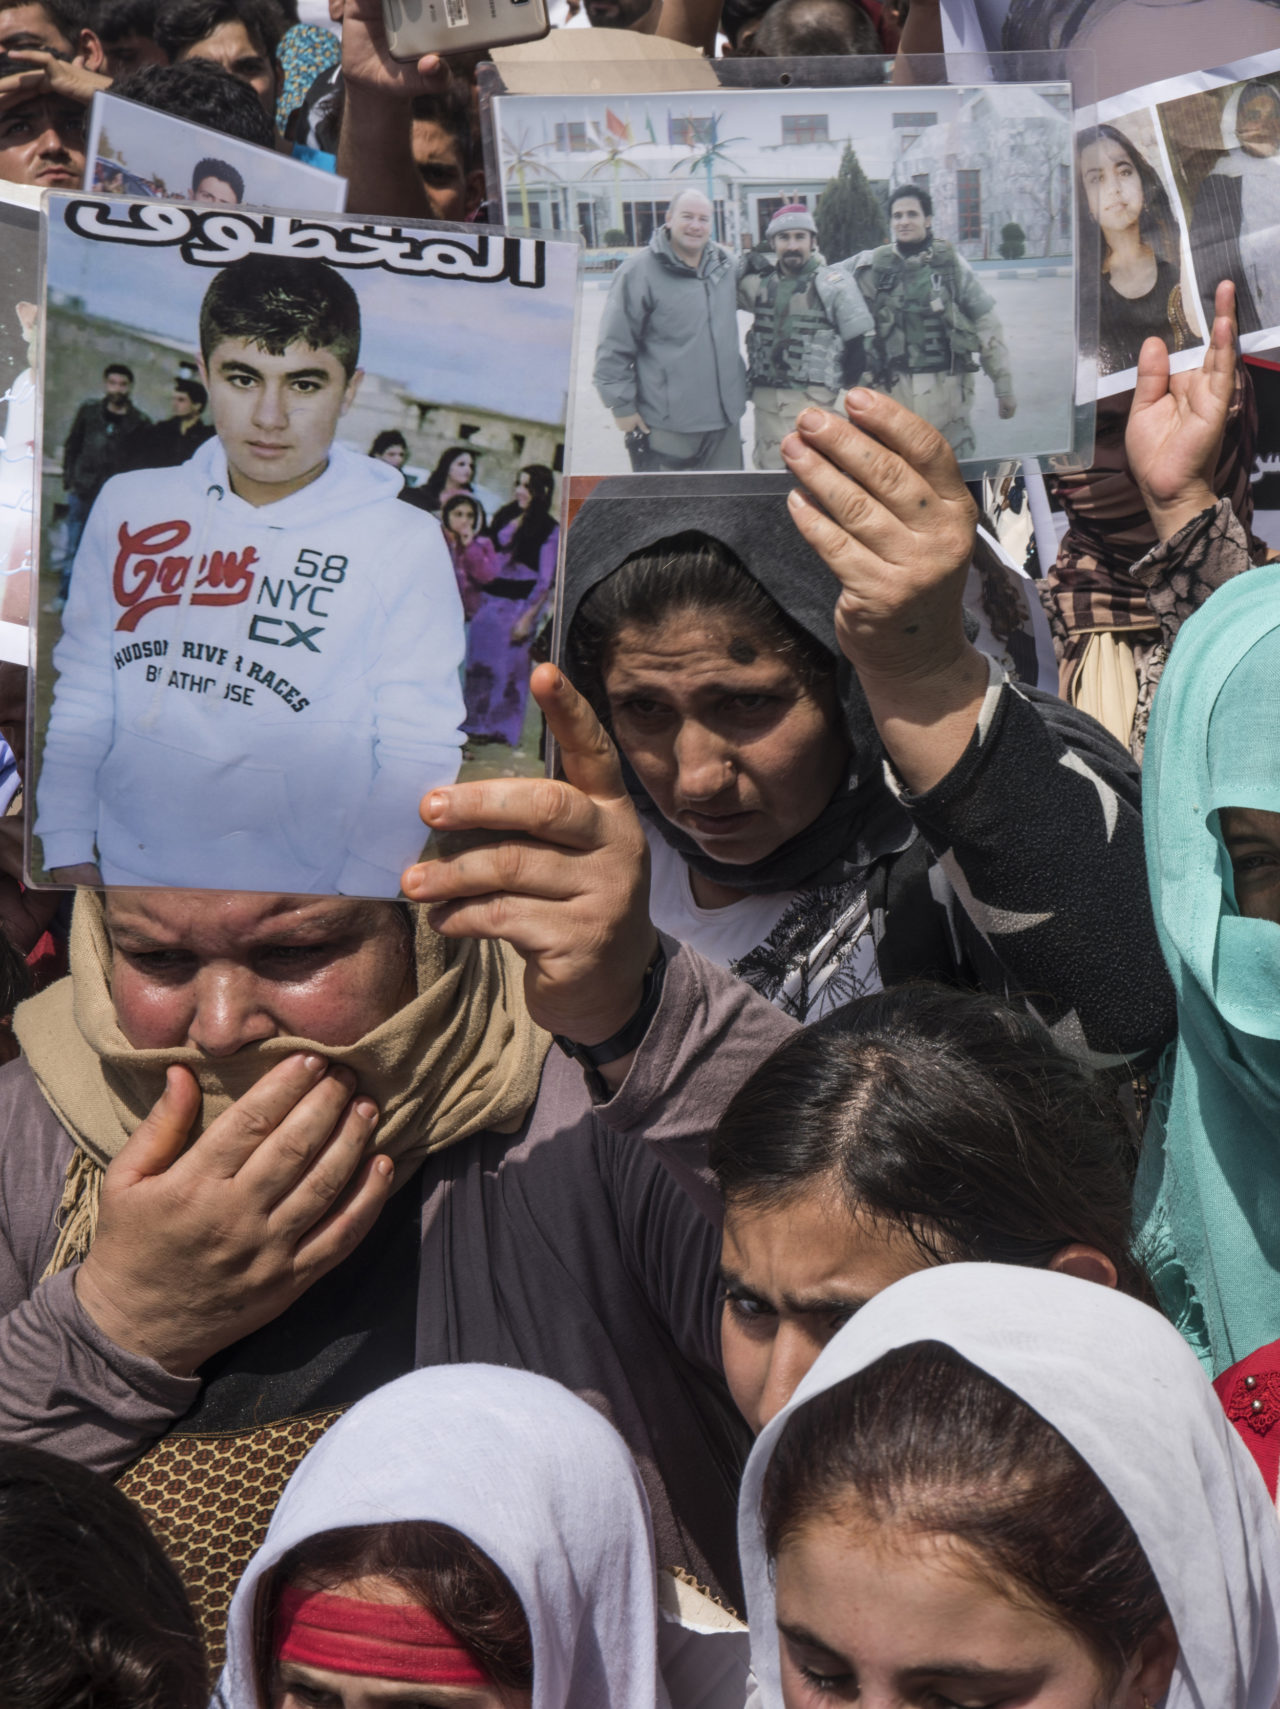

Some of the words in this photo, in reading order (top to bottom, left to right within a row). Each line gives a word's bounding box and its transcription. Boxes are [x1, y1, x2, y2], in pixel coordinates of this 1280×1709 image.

[294, 548, 349, 584] 58
[257, 575, 334, 618] NYC
[248, 614, 326, 653] CX
[146, 664, 256, 706] BATHOSE
[247, 661, 310, 713] RACES
